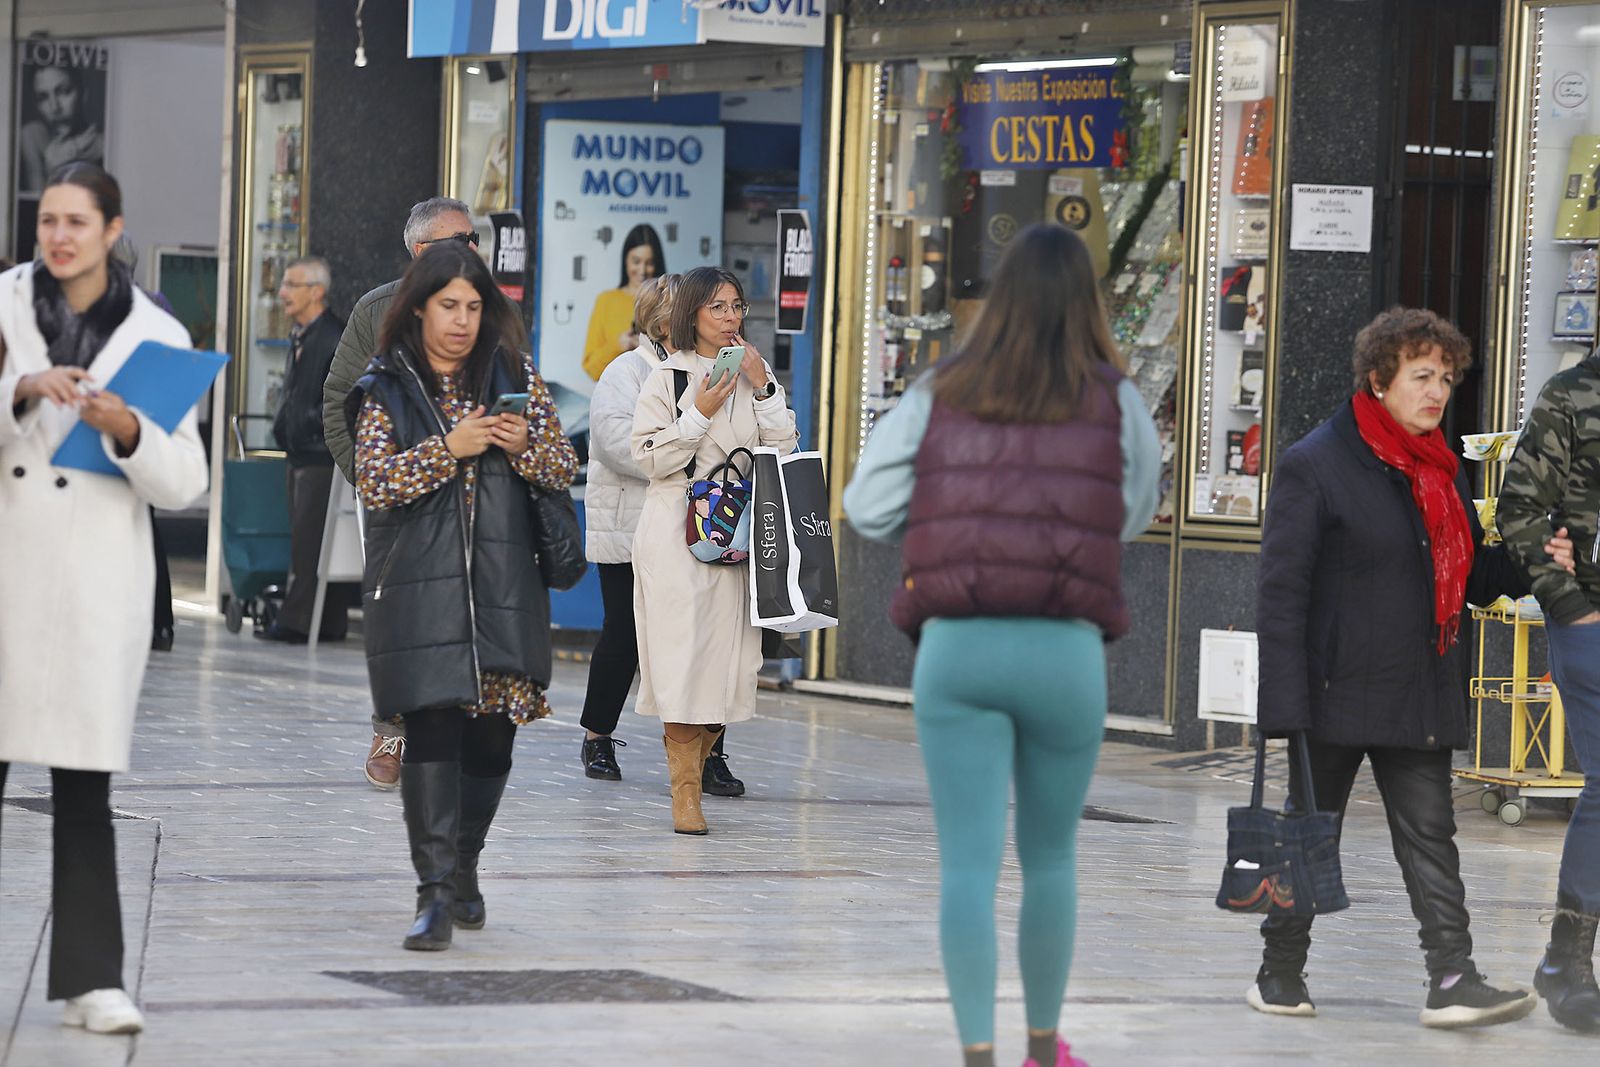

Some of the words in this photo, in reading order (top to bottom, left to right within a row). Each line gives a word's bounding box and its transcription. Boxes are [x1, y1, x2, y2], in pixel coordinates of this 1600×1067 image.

[542, 0, 649, 40] DIGI
[21, 41, 109, 70] LOEWE
[963, 78, 993, 103] Visite
[996, 75, 1038, 102] Nuestra
[1042, 73, 1106, 106] Exposición
[574, 134, 703, 165] MUNDO
[990, 115, 1095, 164] CESTAS
[582, 168, 691, 198] MOVIL
